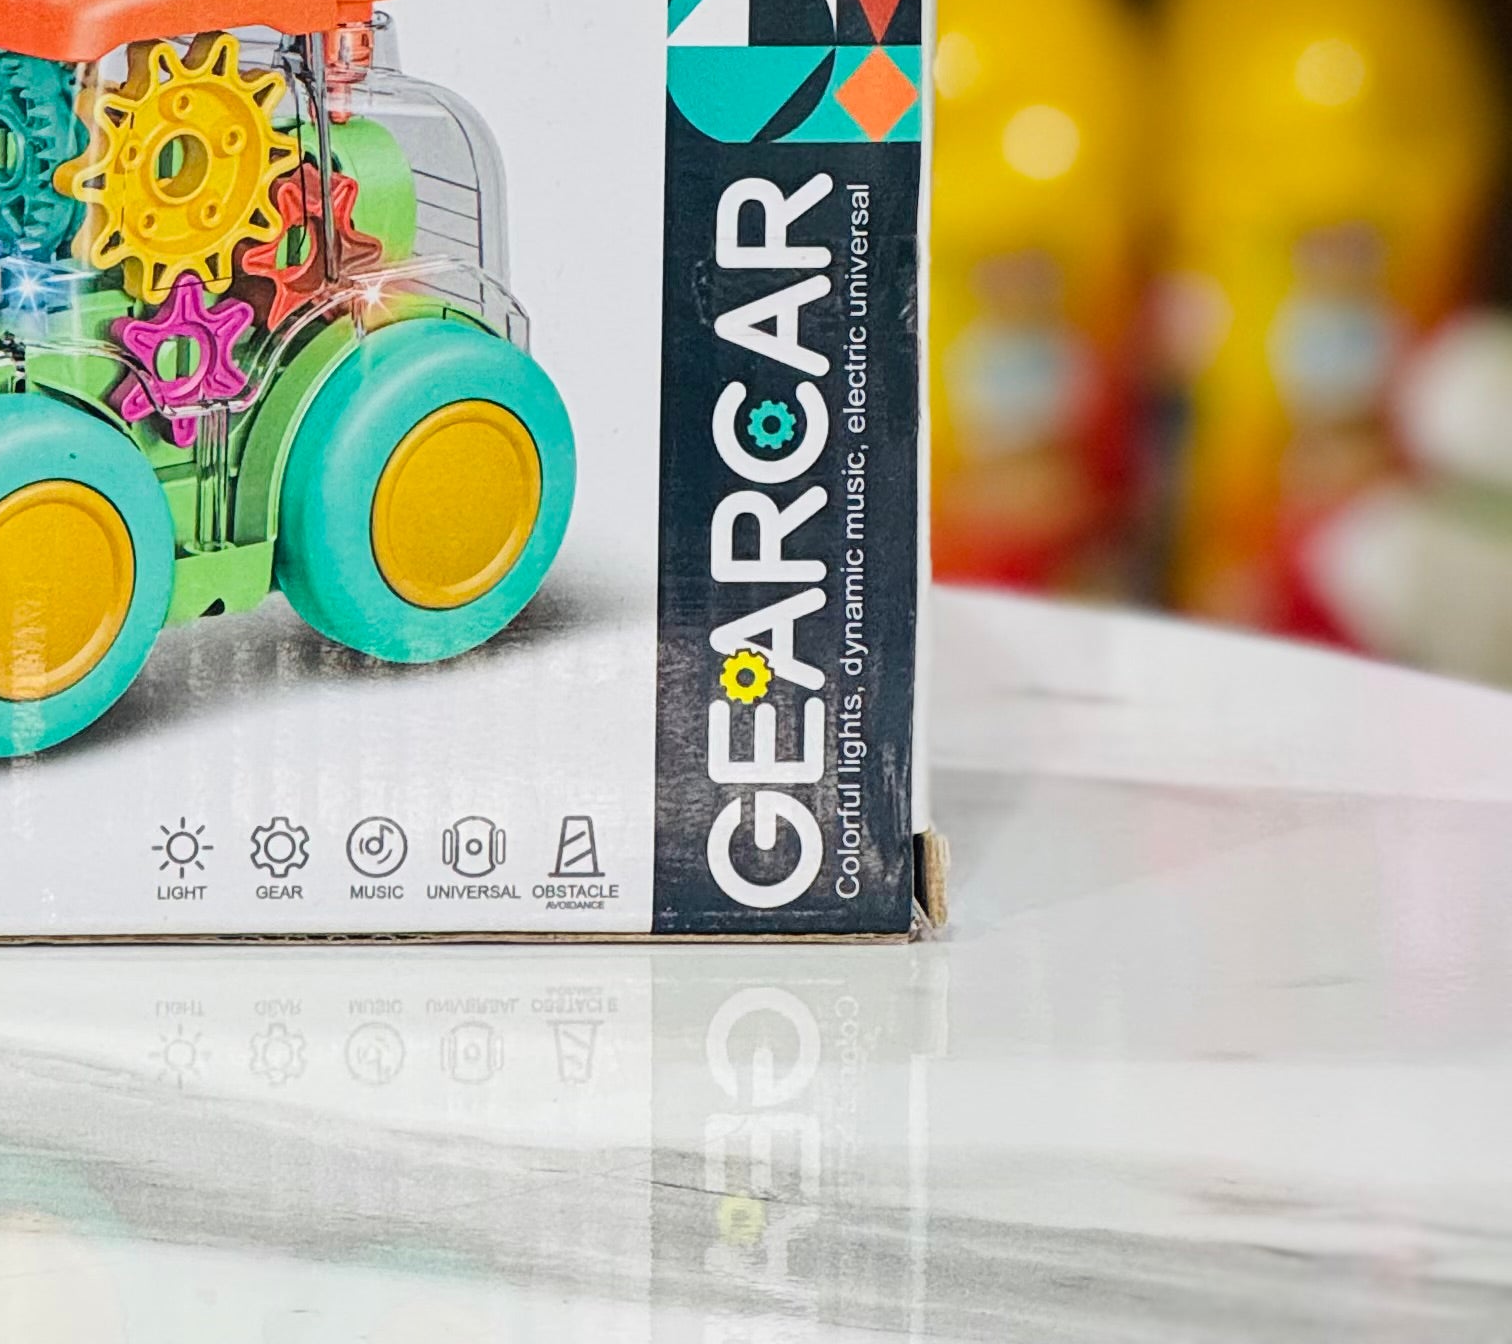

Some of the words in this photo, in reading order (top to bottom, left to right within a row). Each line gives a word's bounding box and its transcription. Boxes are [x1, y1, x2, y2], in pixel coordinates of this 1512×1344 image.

[844, 183, 870, 318] universal
[842, 325, 867, 434] electric
[841, 444, 869, 540] music,
[839, 547, 868, 677] dynamic
[838, 684, 868, 773] lights,
[835, 783, 862, 900] Colorful
[157, 885, 207, 901] LIGHT
[255, 885, 303, 900] GEAR
[350, 885, 405, 900] MUSIC
[426, 885, 521, 900] UNIVERSAL
[532, 884, 620, 899] OBSTACLE
[545, 900, 605, 910] AVOIDANCE
